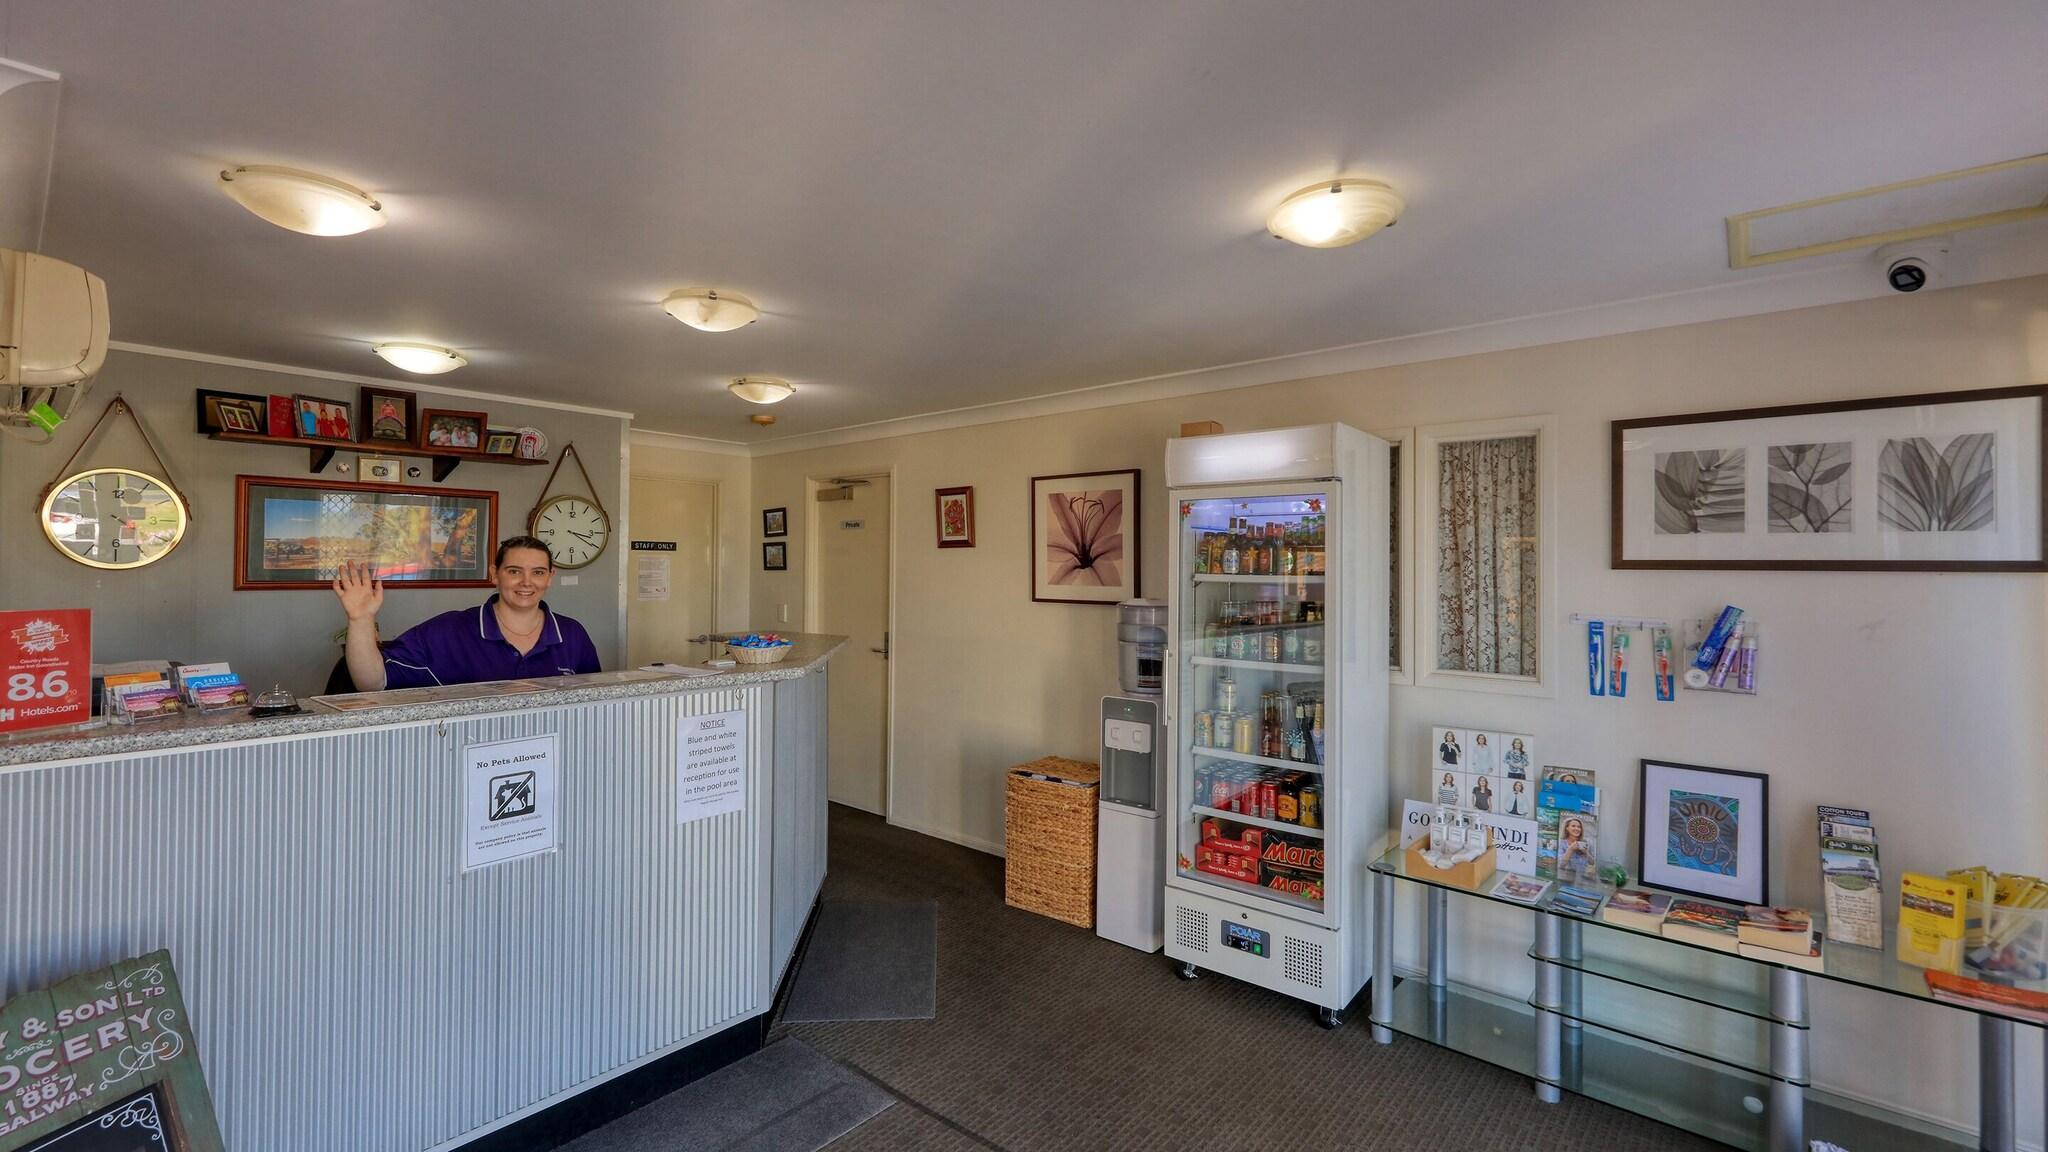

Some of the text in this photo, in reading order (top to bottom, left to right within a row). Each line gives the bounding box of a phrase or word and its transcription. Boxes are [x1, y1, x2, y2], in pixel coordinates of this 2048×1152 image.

[112, 538, 121, 548] 6
[8, 670, 69, 701] 8.6
[20, 704, 79, 717] Hotels.com
[700, 719, 726, 729] NOTICE
[687, 731, 737, 744] Blue and white
[688, 742, 735, 757] striped towels
[476, 752, 546, 769] No Pets Allowed
[699, 755, 729, 768] available
[683, 766, 740, 783] reception for use
[685, 779, 738, 796] in the pool area
[1263, 841, 1324, 869] Mars
[1494, 842, 1528, 853] otton
[1230, 924, 1261, 941] POLAR
[22, 1017, 49, 1040] &
[57, 994, 119, 1028] SON
[16, 1073, 60, 1097] SINCE
